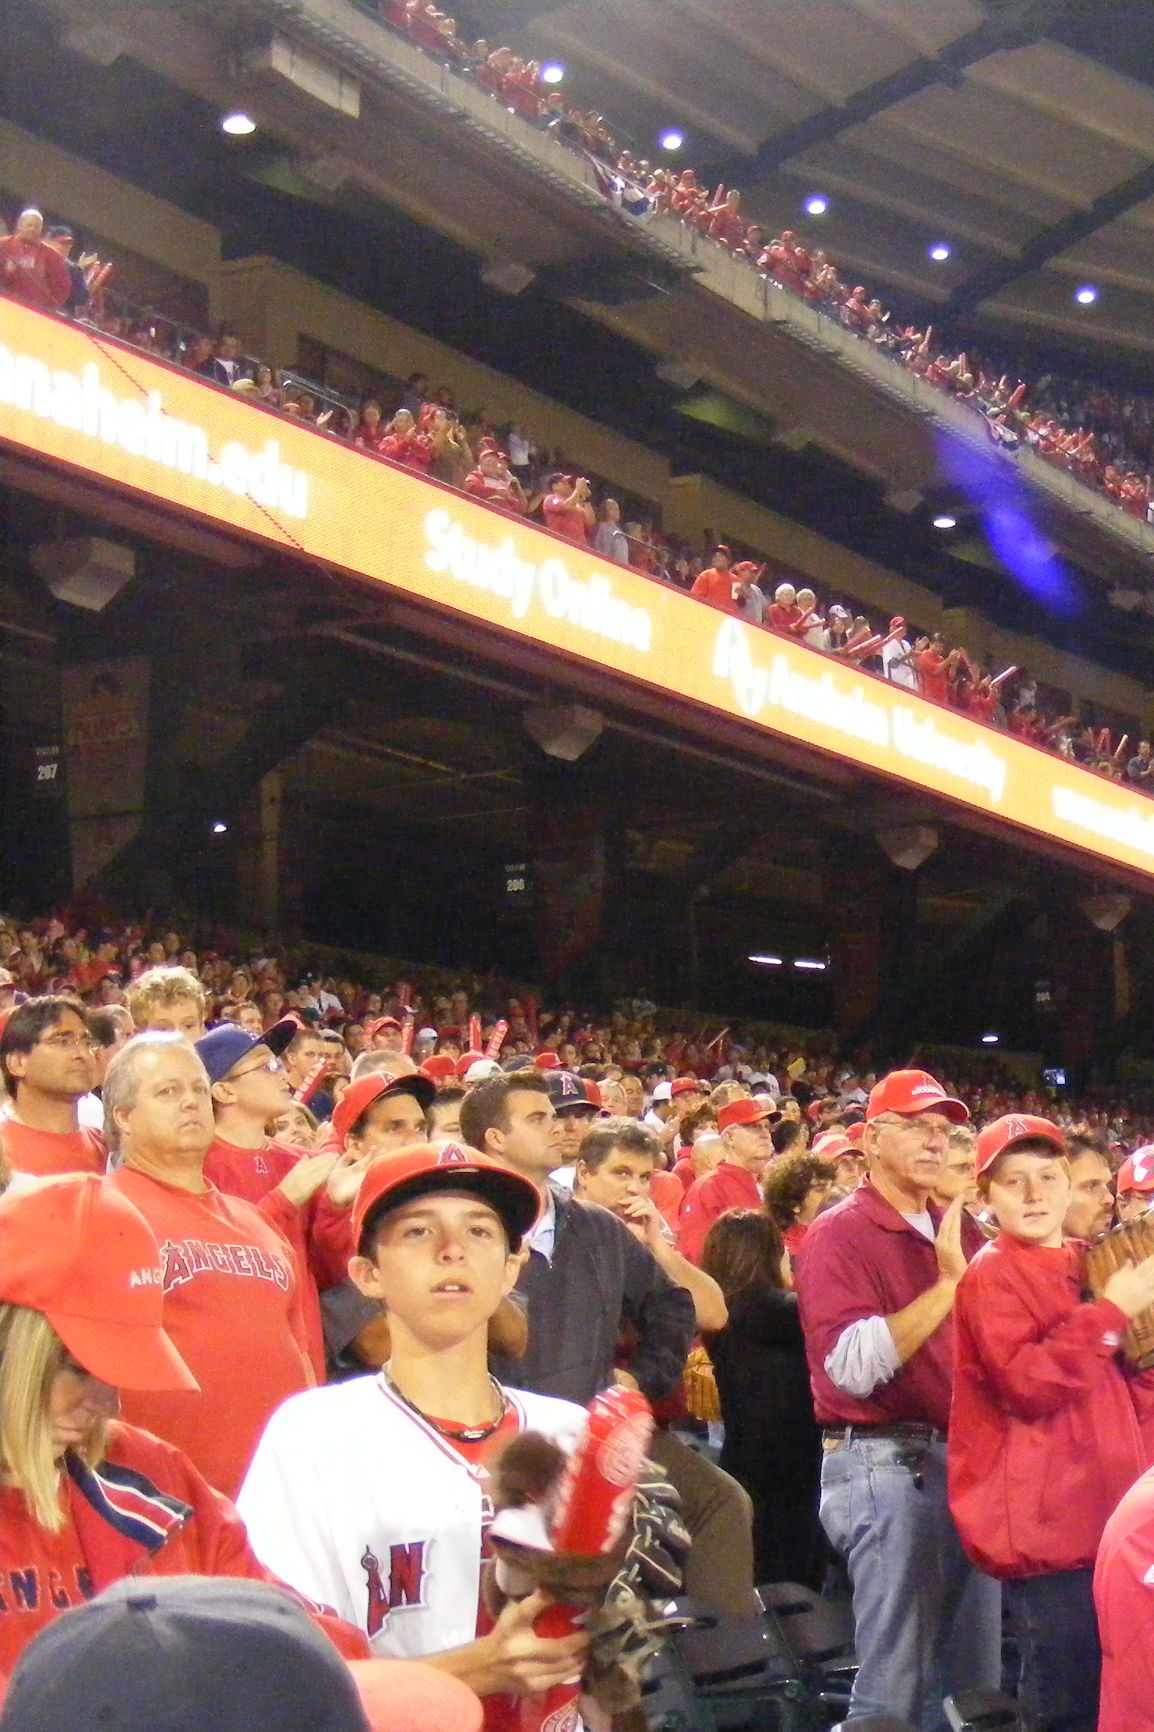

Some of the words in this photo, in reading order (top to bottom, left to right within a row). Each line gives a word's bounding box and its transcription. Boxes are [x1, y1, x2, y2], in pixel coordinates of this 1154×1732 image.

[423, 508, 536, 619] Study
[540, 557, 653, 652] Online
[160, 1239, 289, 1293] ANGELS
